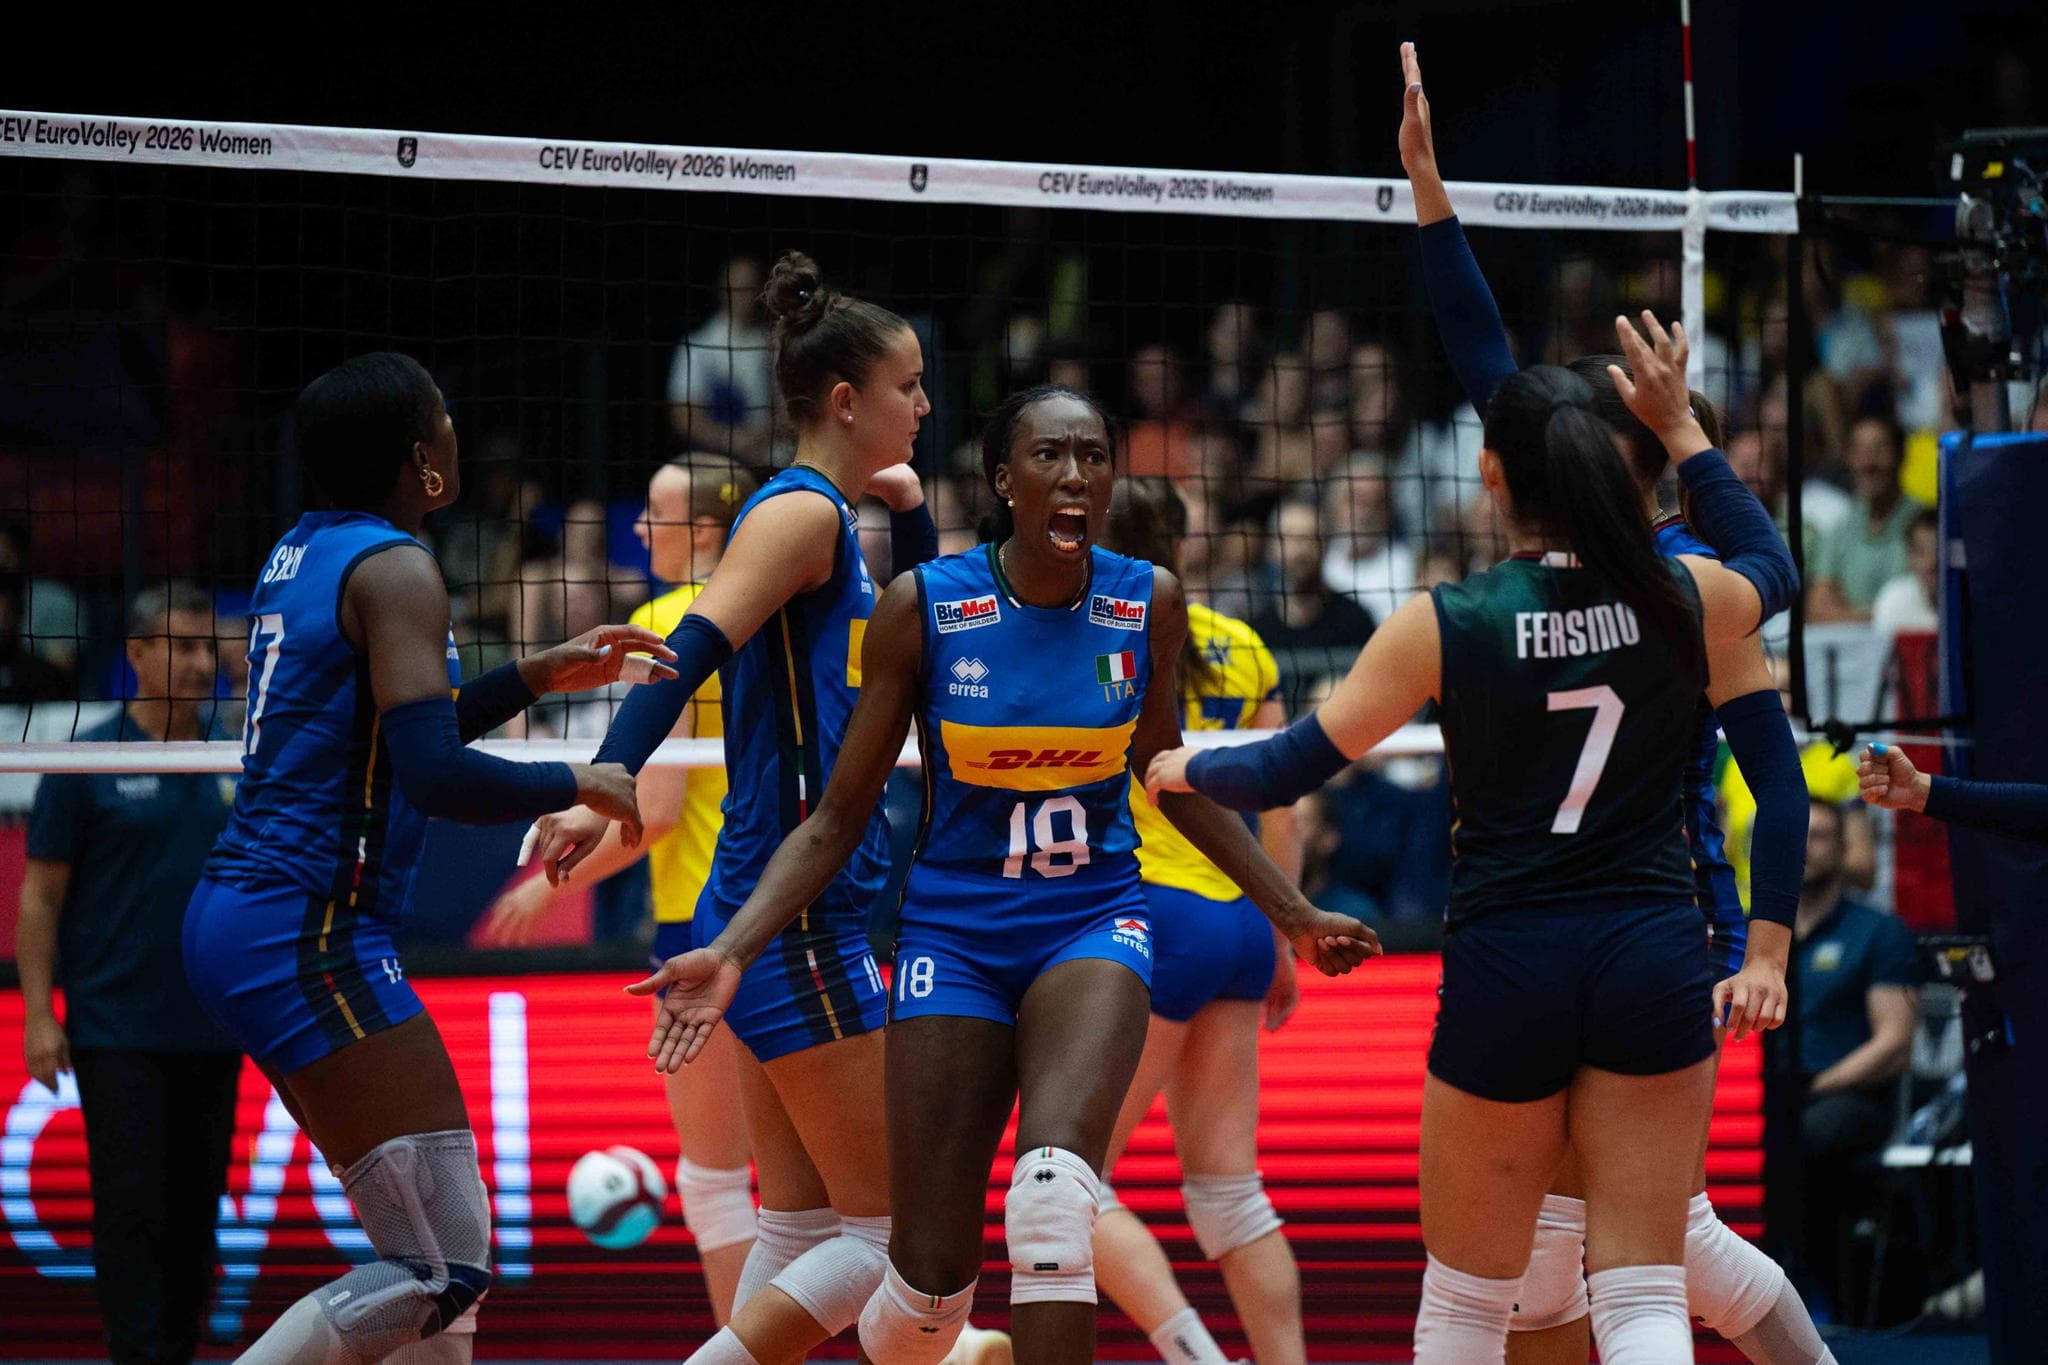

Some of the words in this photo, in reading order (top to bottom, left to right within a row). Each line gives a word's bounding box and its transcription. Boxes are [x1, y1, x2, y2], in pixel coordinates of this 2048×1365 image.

[0, 117, 31, 143] EV
[35, 119, 141, 154] EuroVolley
[144, 125, 194, 151] 2026
[199, 127, 272, 155] Women
[539, 146, 579, 170] CEV
[582, 148, 677, 180] EuroVolley
[681, 153, 725, 178] 2026
[729, 156, 796, 181] Women
[1038, 172, 1076, 194] CEV
[1078, 173, 1167, 204] EuroVolley
[1167, 177, 1209, 199] 2026
[1212, 179, 1275, 201] Women
[935, 598, 997, 622] BigMat
[1092, 596, 1145, 619] BigMat
[939, 624, 959, 632] HOME
[968, 615, 999, 628] BUILDERS
[1089, 616, 1106, 625] HOME
[1114, 620, 1142, 630] BUILDERS
[1515, 602, 1641, 659] FERSINO
[949, 682, 989, 698] errea
[1104, 680, 1136, 703] ITA
[986, 749, 1103, 770] DHL
[1547, 685, 1626, 834] 7
[1003, 795, 1091, 879] 18
[1112, 934, 1149, 959] errea
[899, 956, 935, 1002] 18
